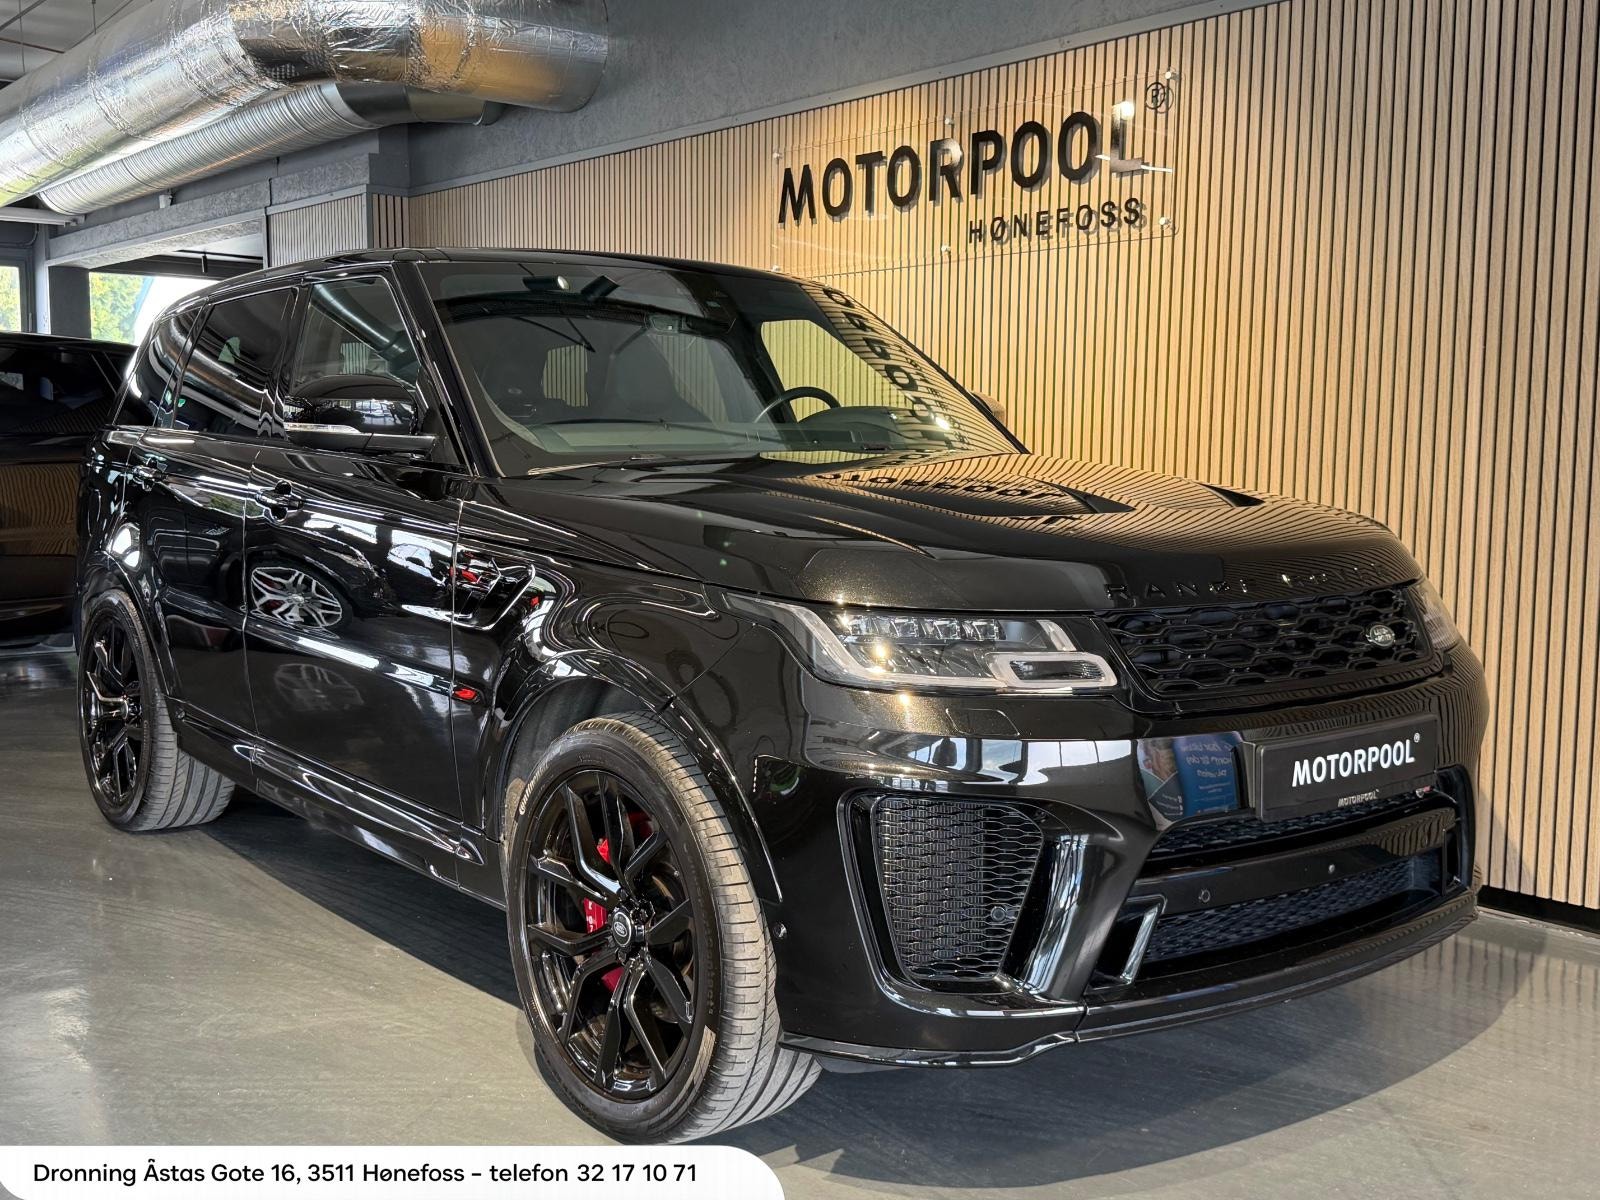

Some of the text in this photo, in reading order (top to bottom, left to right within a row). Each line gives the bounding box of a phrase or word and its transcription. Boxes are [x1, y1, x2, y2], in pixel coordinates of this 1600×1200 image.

[778, 100, 1144, 224] MOTORPOOL
[969, 198, 1141, 243] HØNEFOSS
[1292, 739, 1415, 787] MOTORPOOL
